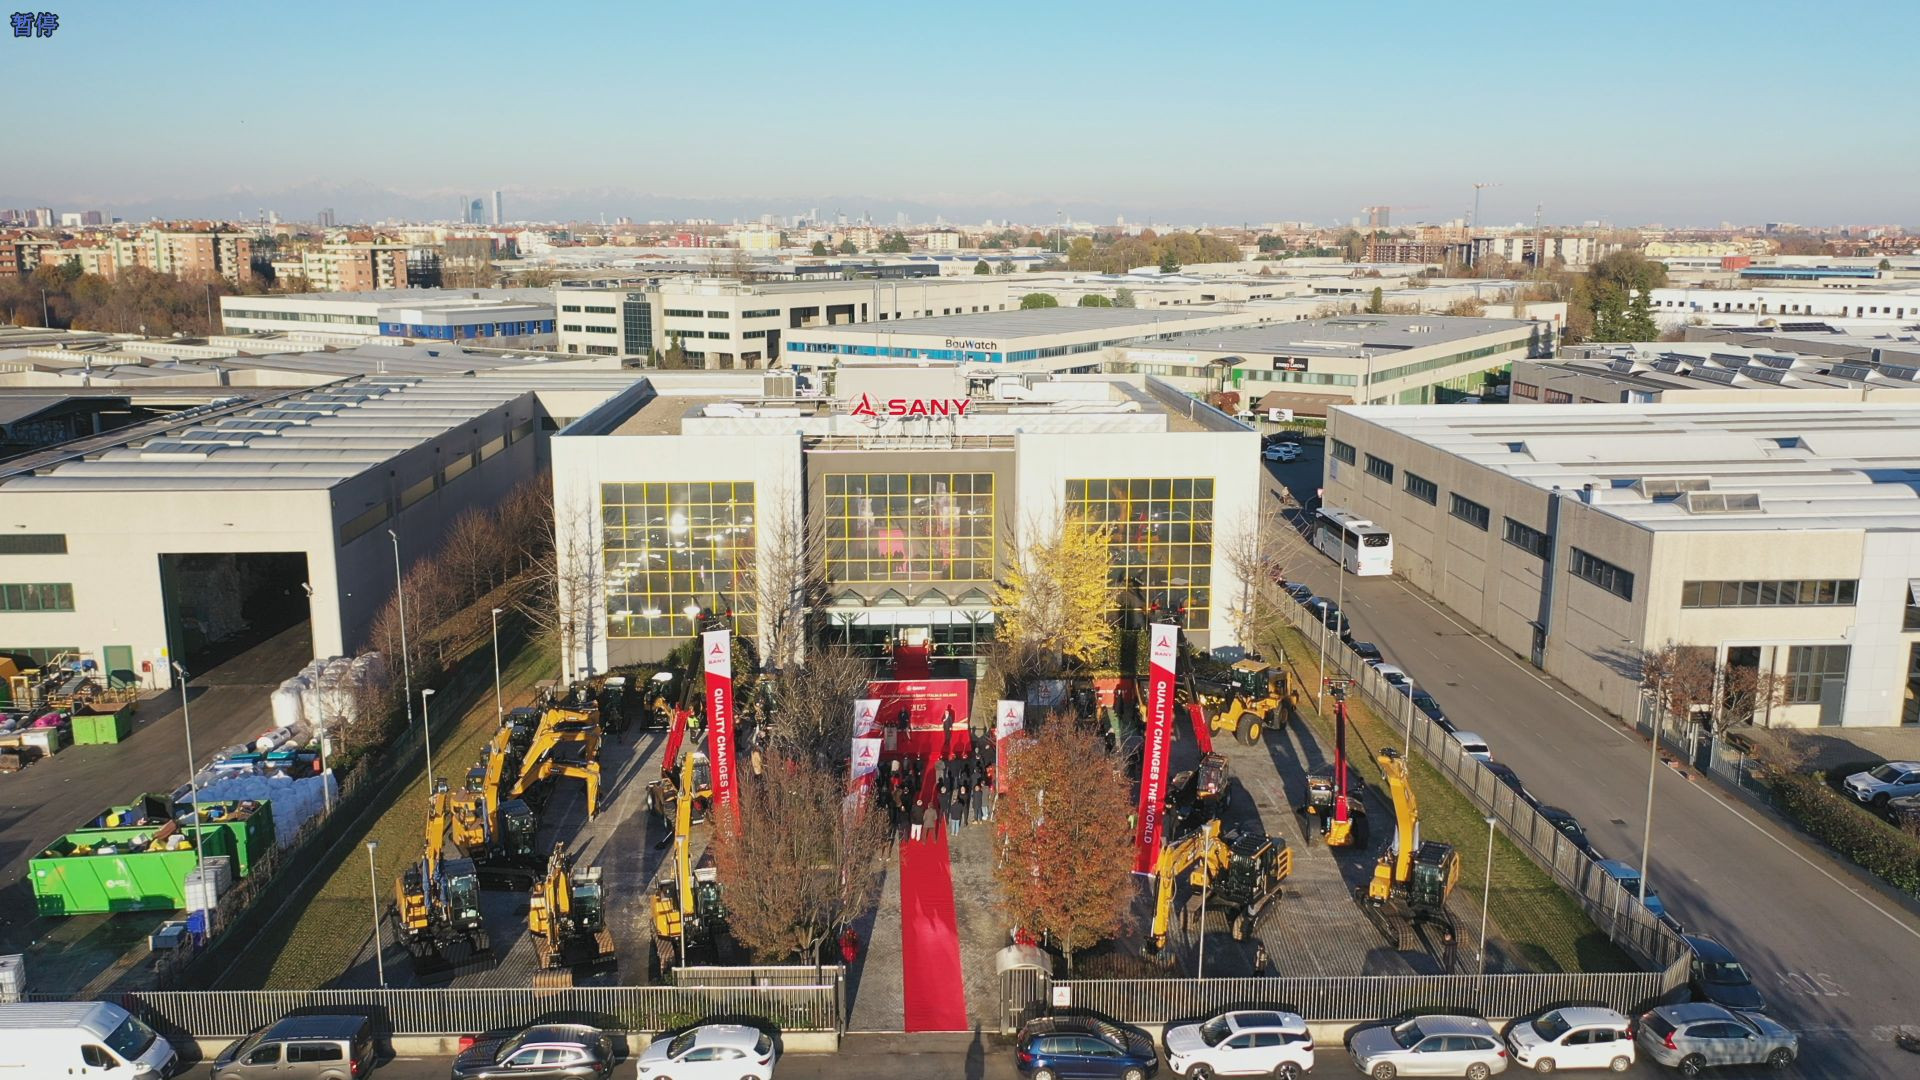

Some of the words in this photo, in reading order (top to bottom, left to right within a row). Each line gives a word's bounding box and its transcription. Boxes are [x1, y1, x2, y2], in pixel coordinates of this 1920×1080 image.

[945, 338, 997, 350] BauWatch
[888, 399, 971, 416] SANY
[714, 688, 725, 733] QUALITY
[1155, 680, 1166, 728] QUALITY
[717, 735, 728, 787] CHANGES
[1150, 728, 1163, 780] CHANGES
[1147, 782, 1158, 803] THE
[1144, 804, 1156, 844] WORLD
